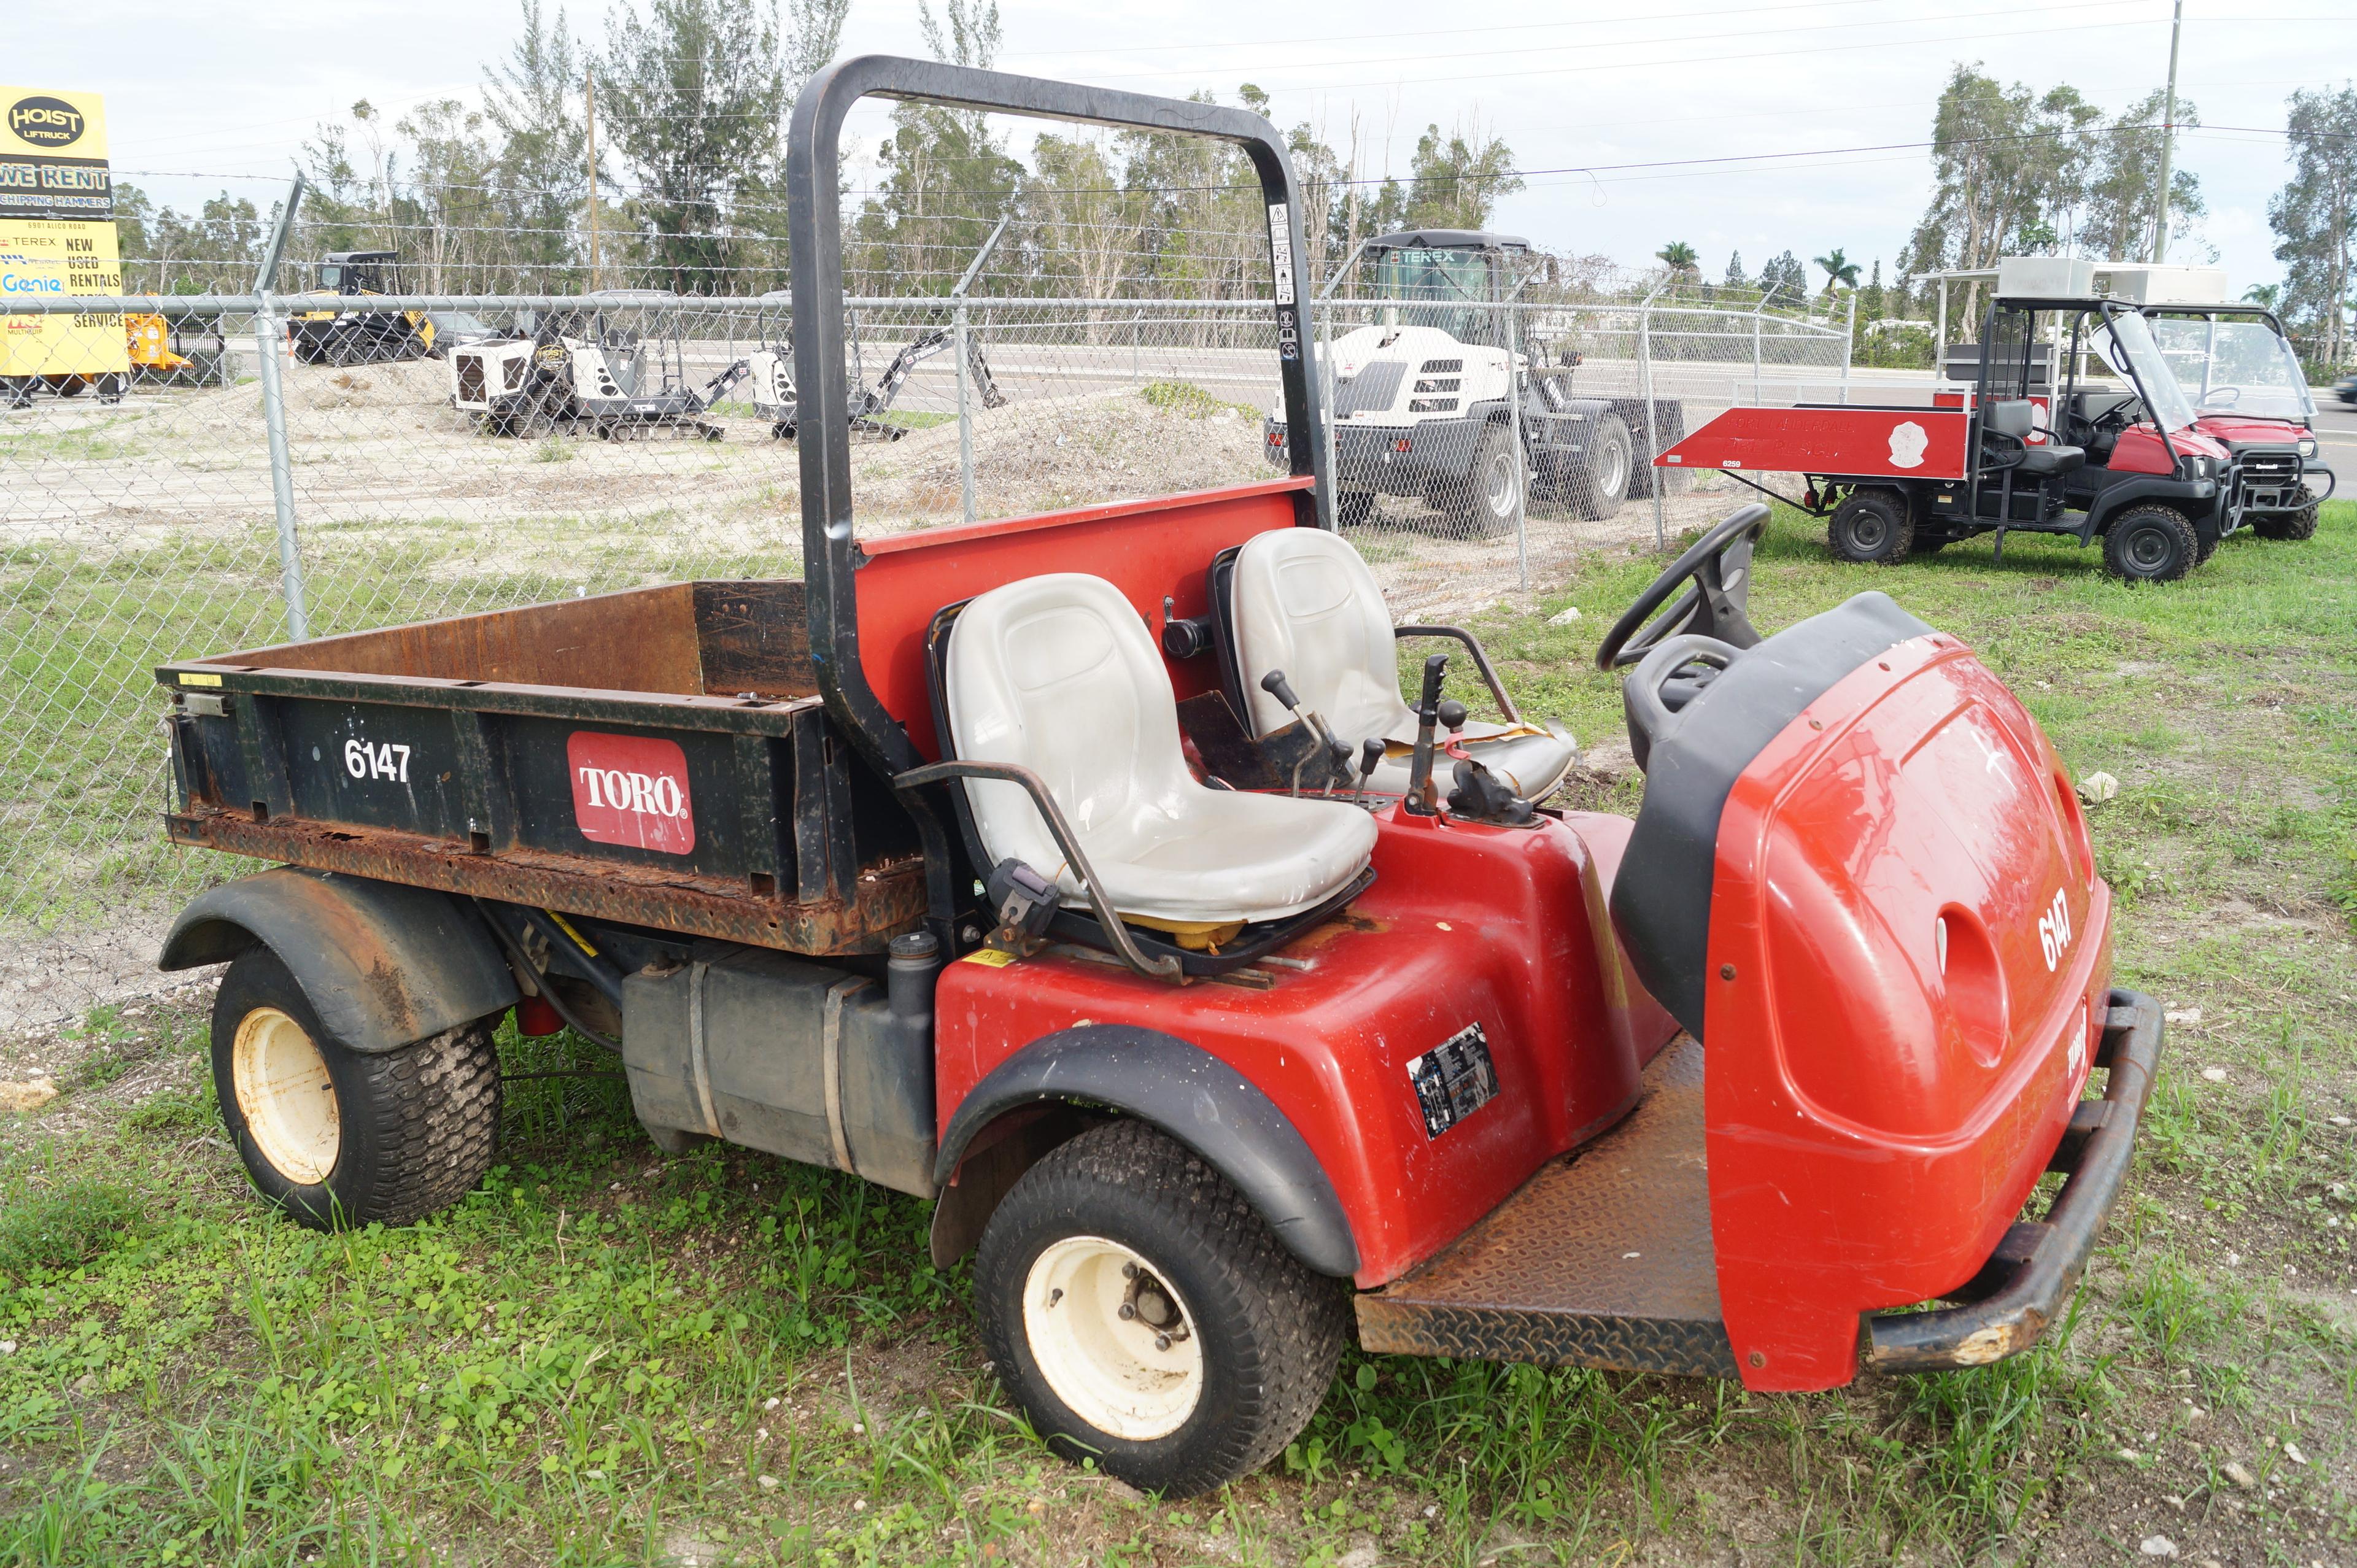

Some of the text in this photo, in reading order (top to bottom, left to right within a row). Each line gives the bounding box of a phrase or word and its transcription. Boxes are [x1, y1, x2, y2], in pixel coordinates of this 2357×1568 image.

[12, 109, 80, 133] HOIST
[24, 130, 71, 140] LIFTRUCK
[41, 164, 109, 190] RENT
[55, 195, 111, 209] HAMMERS
[12, 238, 56, 246] TEREX
[66, 238, 93, 252] NEW
[68, 256, 99, 269] USED
[1403, 250, 1455, 263] TEREX
[2, 274, 62, 292] Genie
[69, 274, 120, 287] RENTALS
[74, 314, 123, 328] SERVICE
[913, 345, 942, 360] TEREX
[345, 739, 411, 782] 6147
[2038, 887, 2072, 973] 6147
